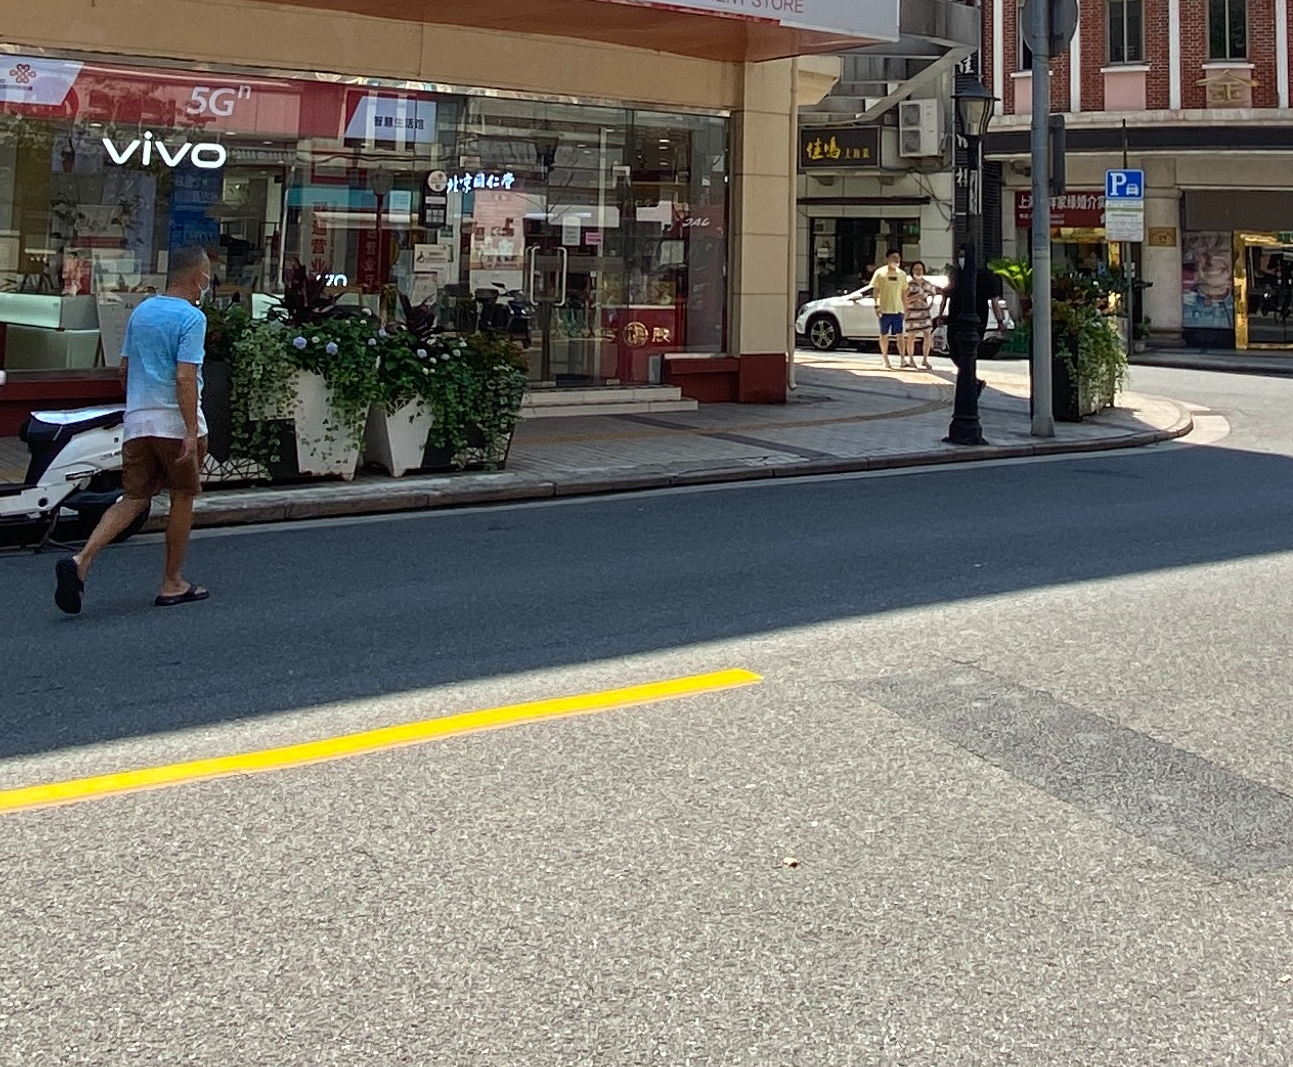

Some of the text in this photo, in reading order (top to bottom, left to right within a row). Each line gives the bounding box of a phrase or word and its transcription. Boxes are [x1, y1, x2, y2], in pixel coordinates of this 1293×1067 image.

[373, 115, 425, 131] 智慧生活馆
[102, 130, 227, 169] vivo
[447, 171, 516, 194] 北京同仁堂
[1109, 172, 1127, 197] P
